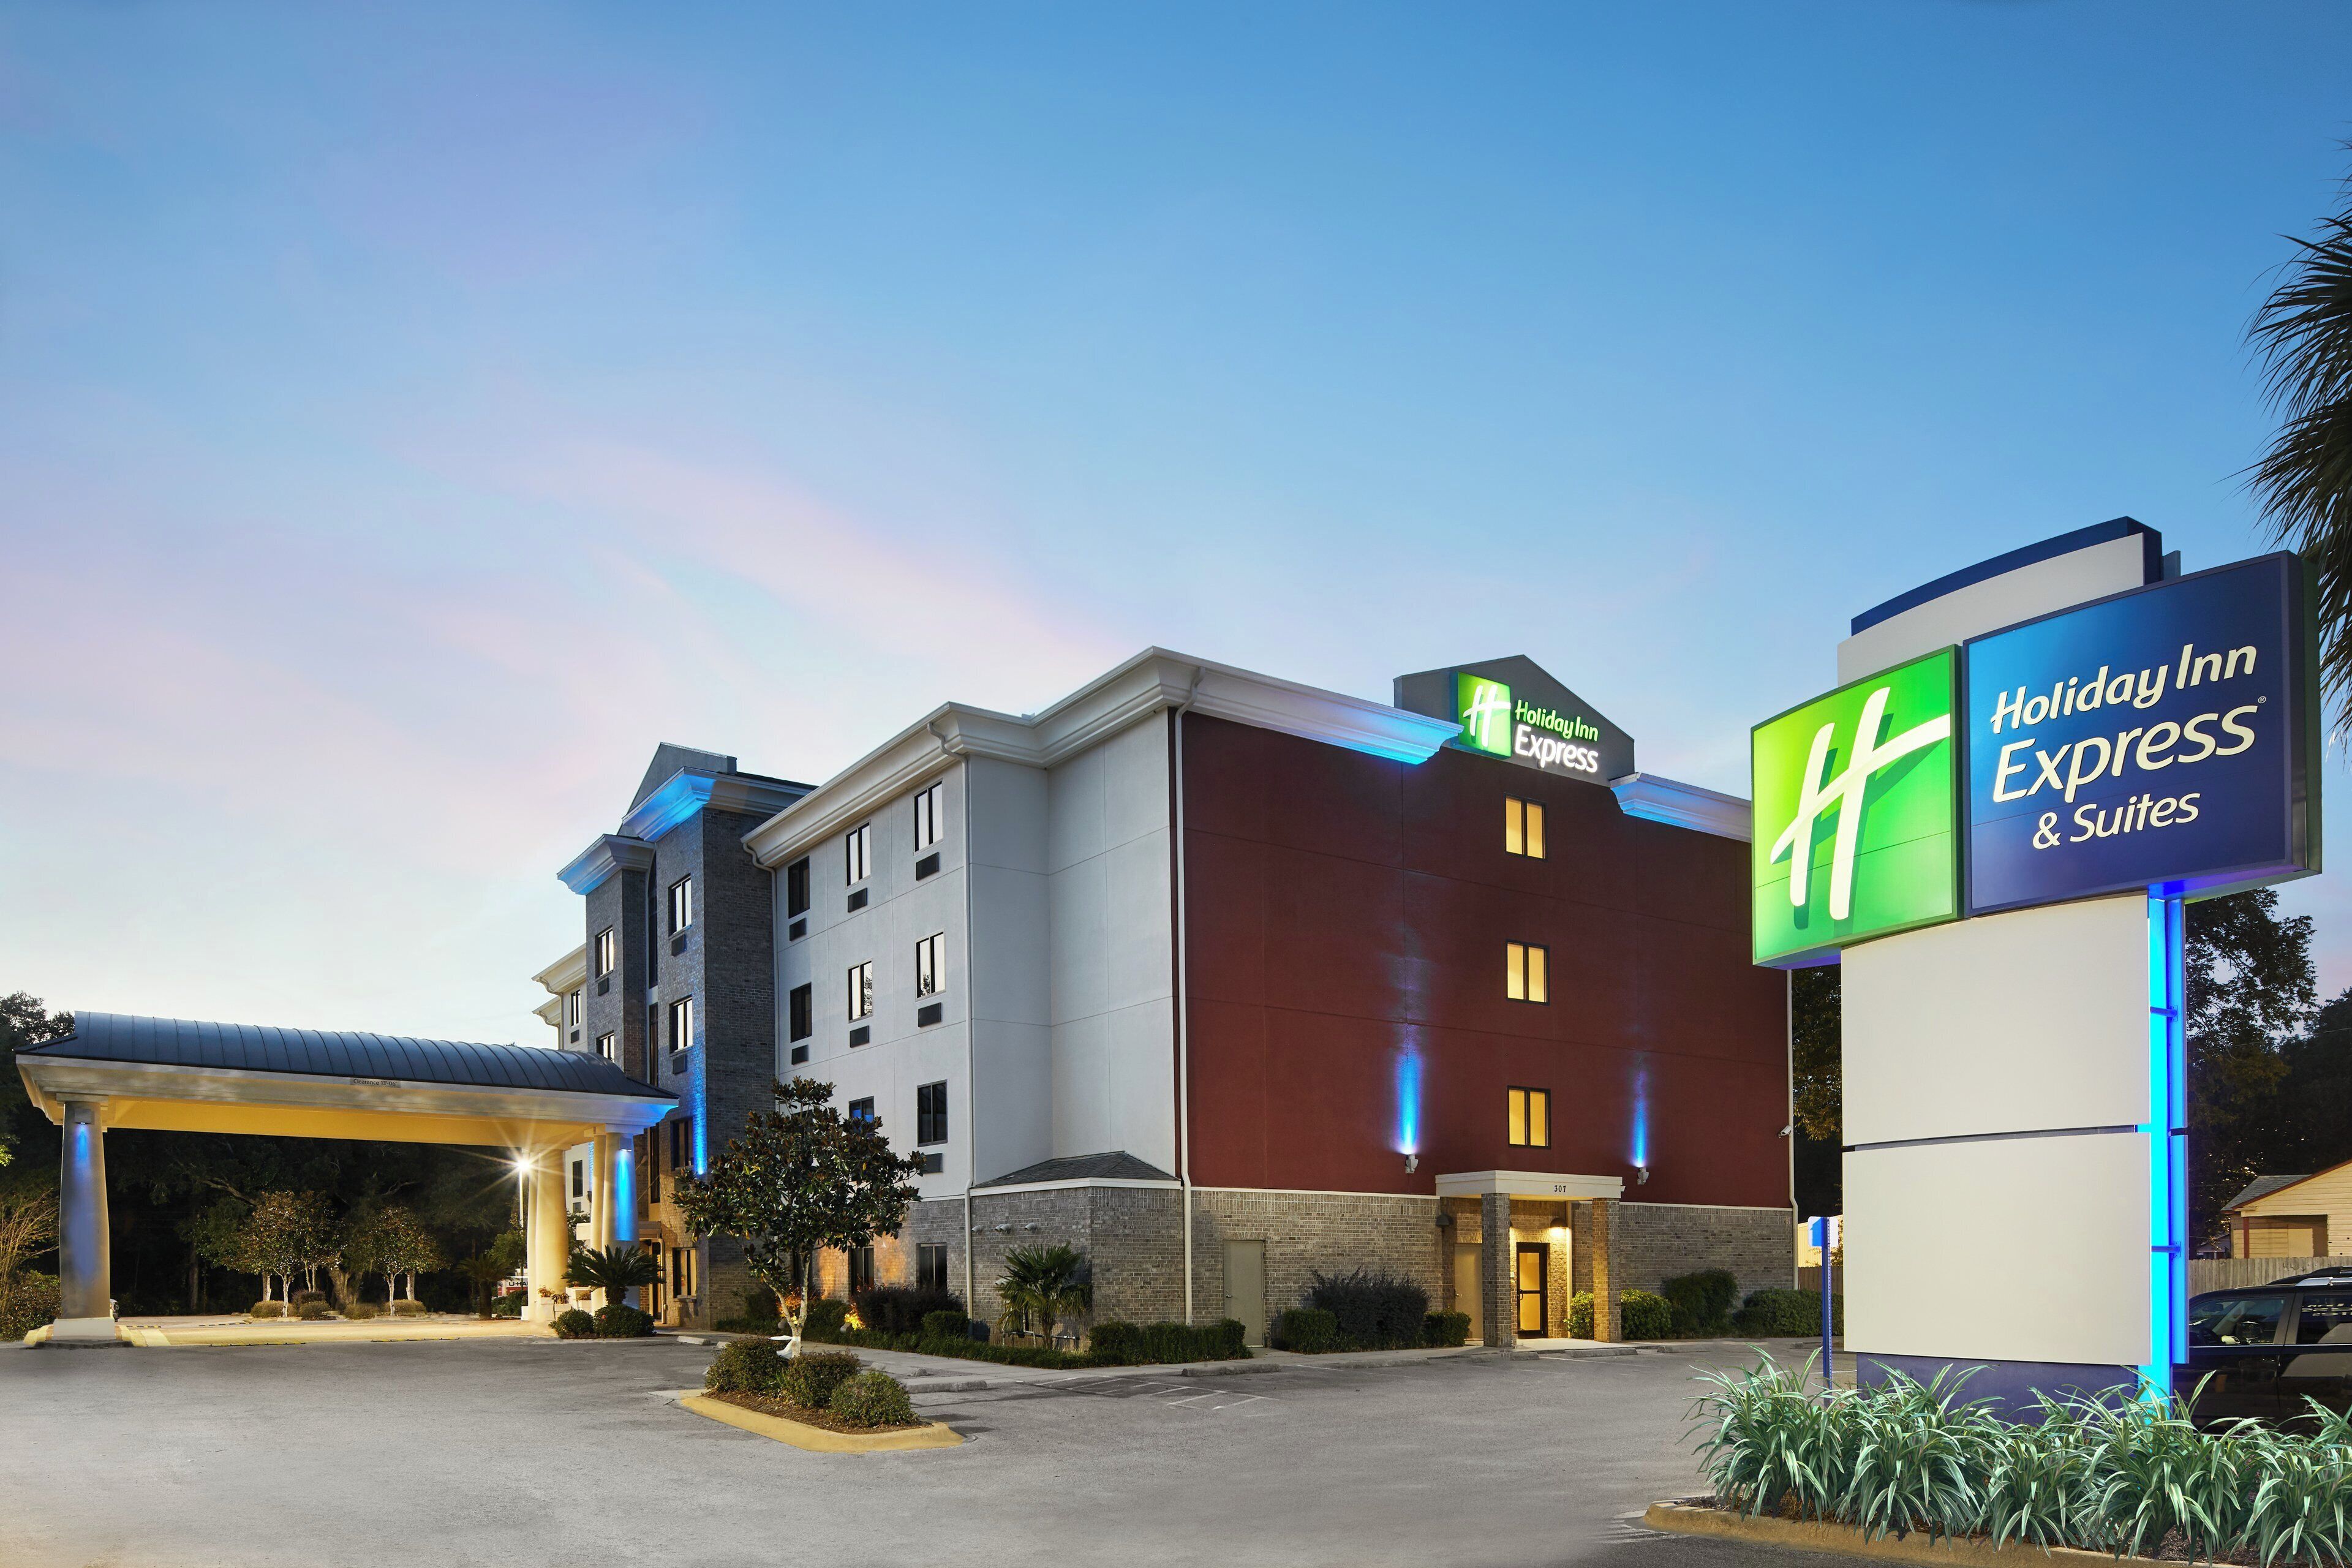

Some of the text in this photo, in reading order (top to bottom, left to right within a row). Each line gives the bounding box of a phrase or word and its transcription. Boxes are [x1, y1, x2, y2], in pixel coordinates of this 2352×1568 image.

[1990, 643, 2257, 735] Holiday Inn
[1515, 699, 1599, 742] Holiday Inn
[1514, 723, 1599, 773] Express
[2032, 793, 2201, 850] & Suites
